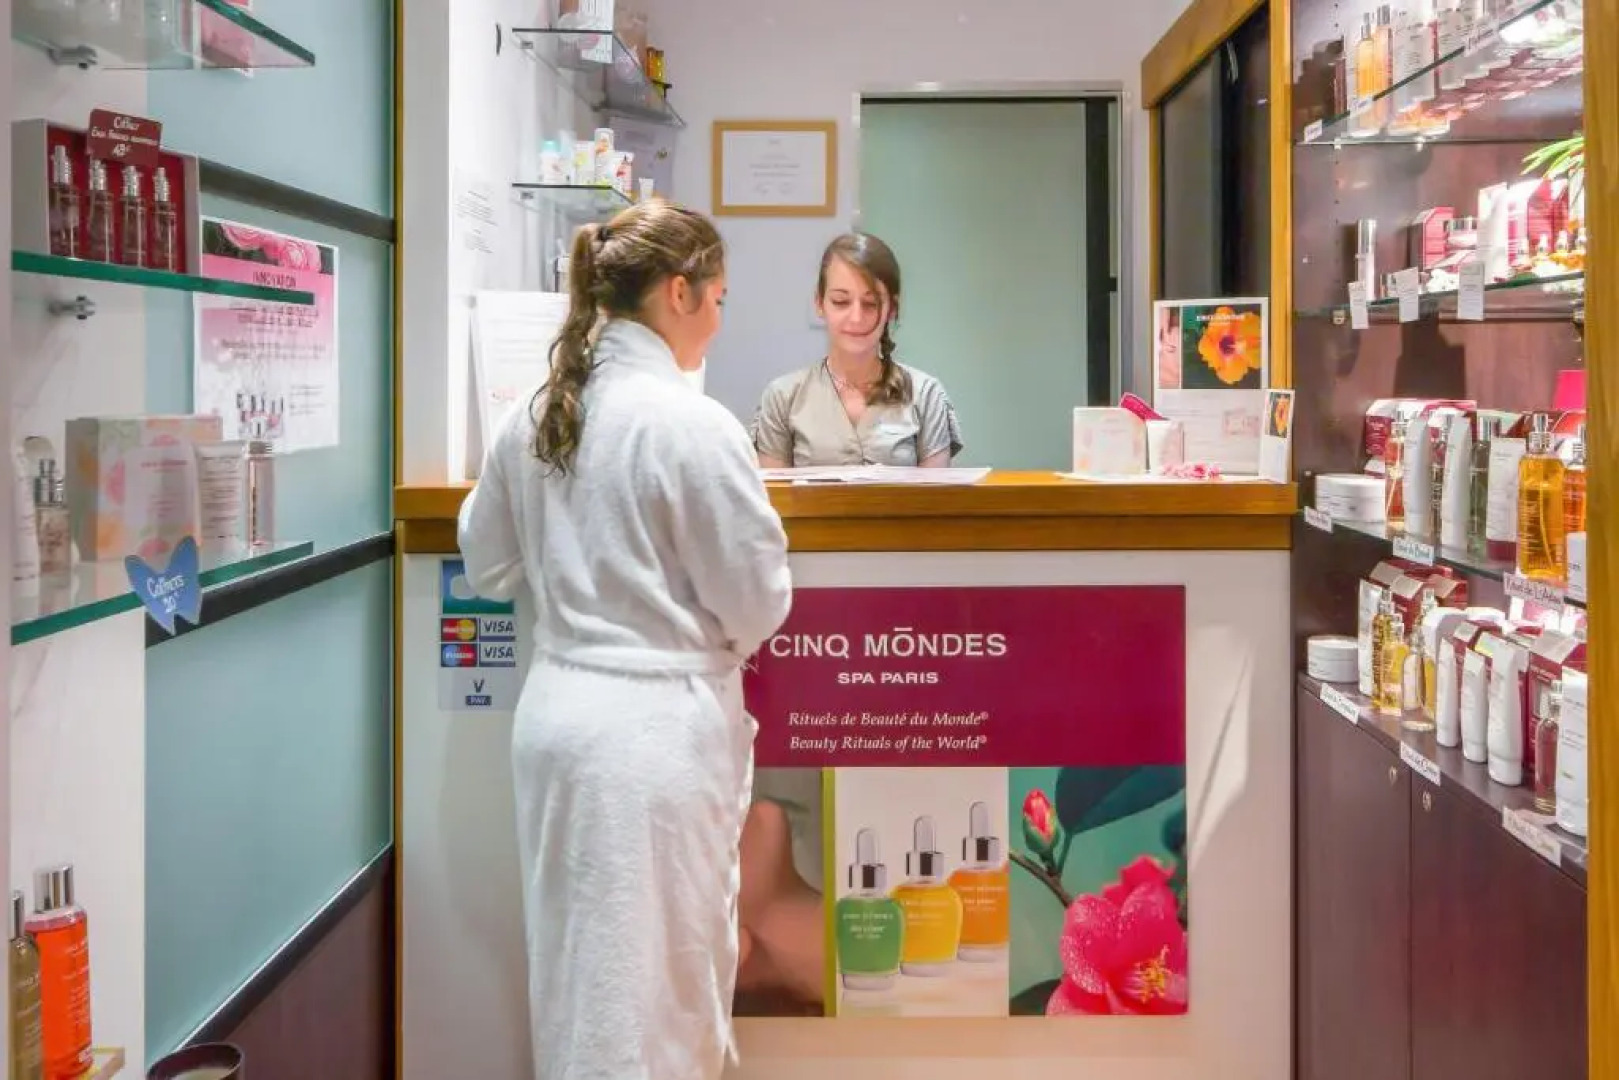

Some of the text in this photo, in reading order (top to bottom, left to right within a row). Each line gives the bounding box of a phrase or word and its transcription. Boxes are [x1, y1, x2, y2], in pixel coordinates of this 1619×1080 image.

[484, 620, 513, 632] VISA
[484, 646, 513, 658] VISA
[769, 633, 850, 659] CINQ
[837, 672, 939, 684] SPA PARIS
[788, 712, 837, 726] Rituels
[840, 712, 857, 726] de
[860, 711, 908, 726] Beauté
[910, 712, 928, 726] du
[790, 736, 838, 753] Beauty
[841, 736, 891, 749] Rituals
[894, 736, 910, 753] of
[911, 736, 933, 749] the
